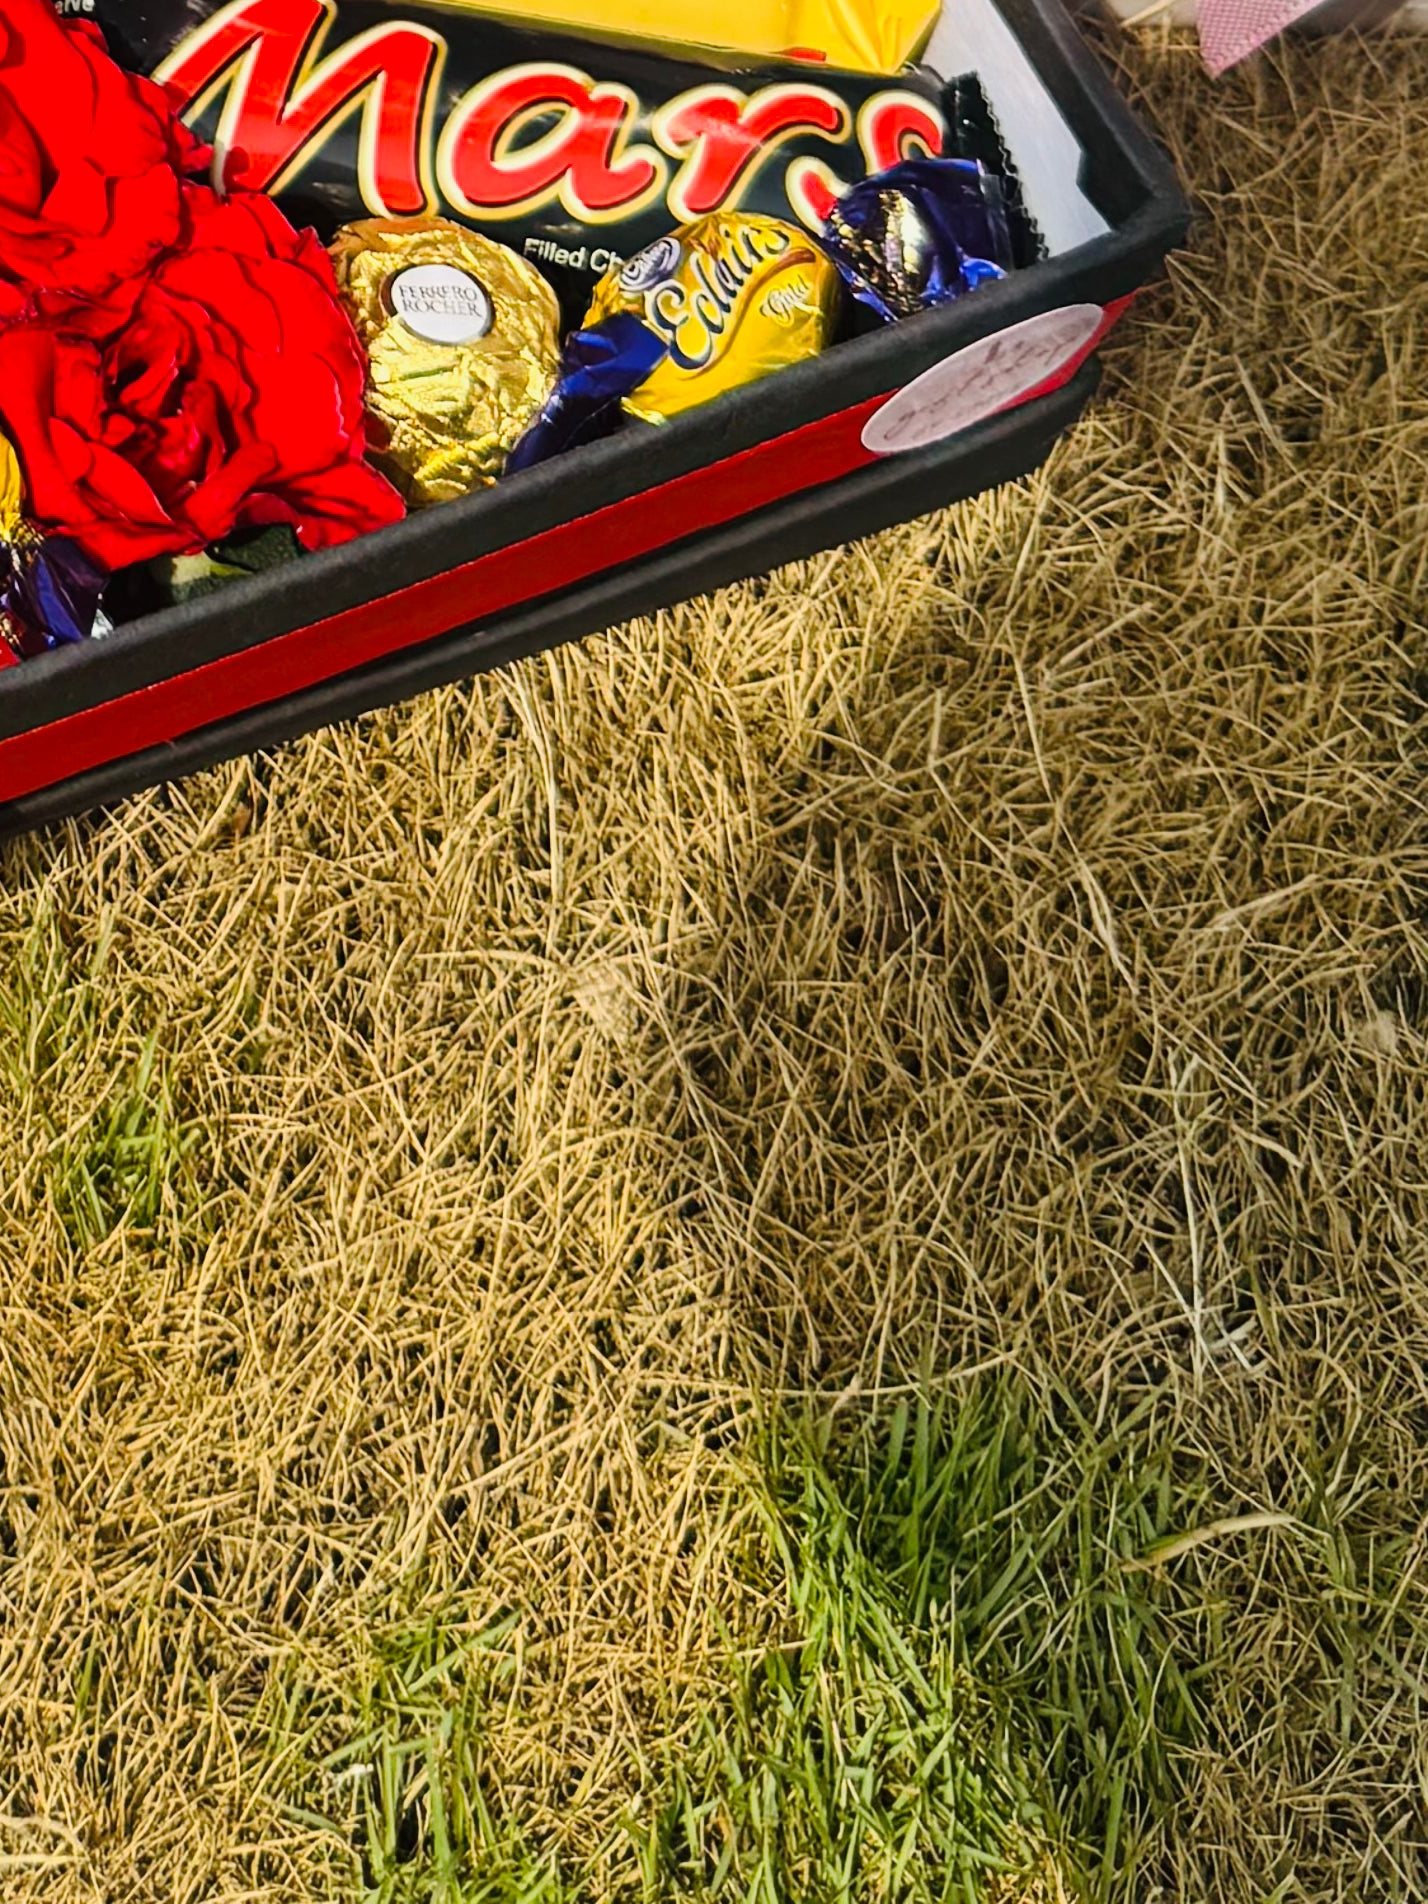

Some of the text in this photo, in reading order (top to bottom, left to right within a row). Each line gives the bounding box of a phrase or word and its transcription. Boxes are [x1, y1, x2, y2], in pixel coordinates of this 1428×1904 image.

[524, 237, 584, 269] Filled
[398, 280, 478, 304] FERRERO
[645, 226, 791, 370] Eclairs
[402, 297, 482, 320] ROCHER
